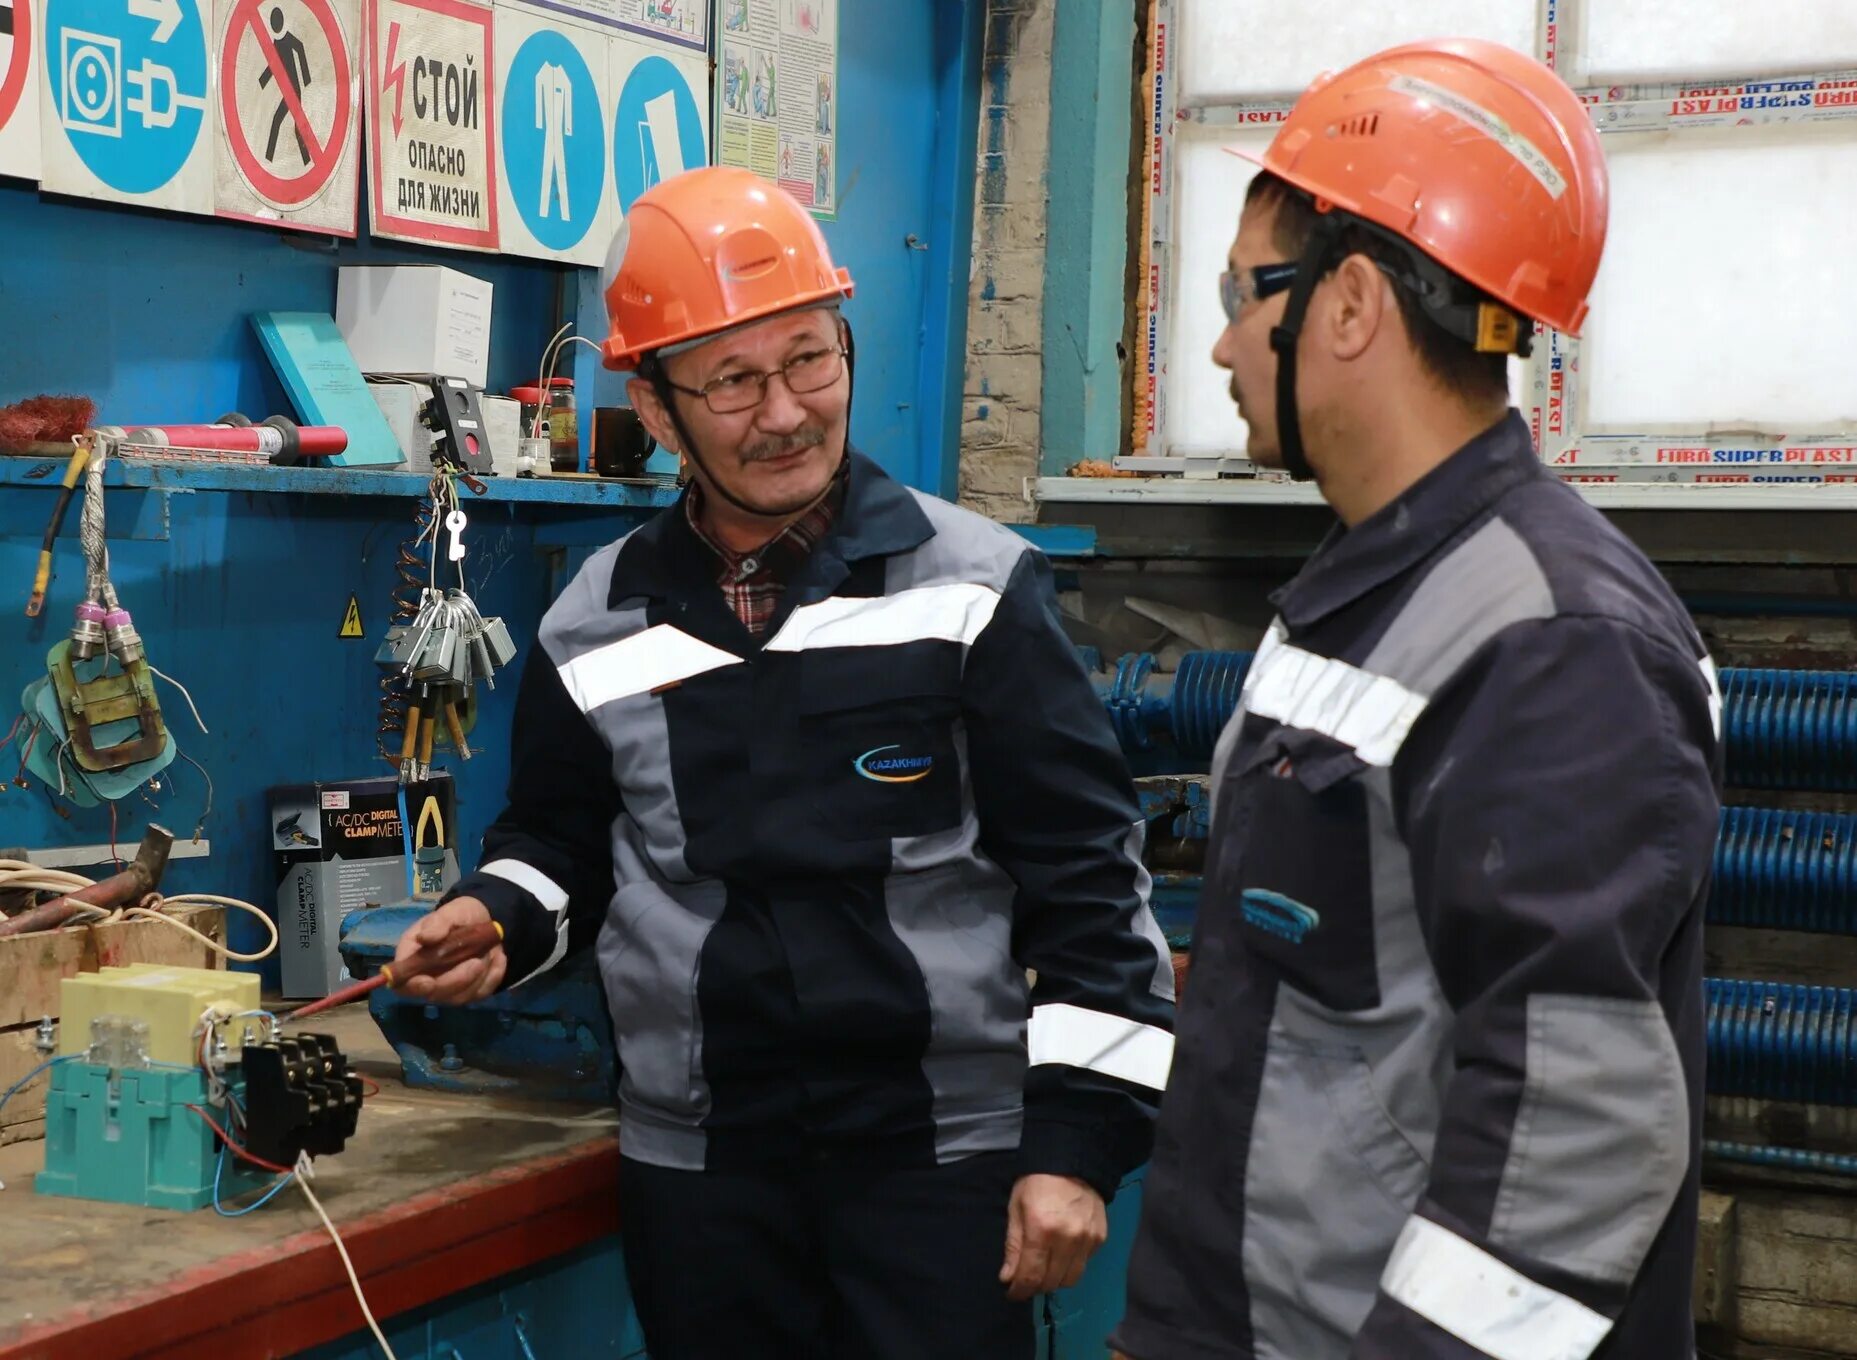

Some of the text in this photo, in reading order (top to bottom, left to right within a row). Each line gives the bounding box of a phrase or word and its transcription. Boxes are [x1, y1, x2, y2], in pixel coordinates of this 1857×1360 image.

[413, 54, 477, 130] СТОЙ
[409, 139, 465, 177] ОПАСНО
[398, 178, 480, 218] ДЛЯ ЖИЗНИ
[335, 810, 398, 828] AC/DC DIGITAL
[309, 903, 317, 935] DIGITAL
